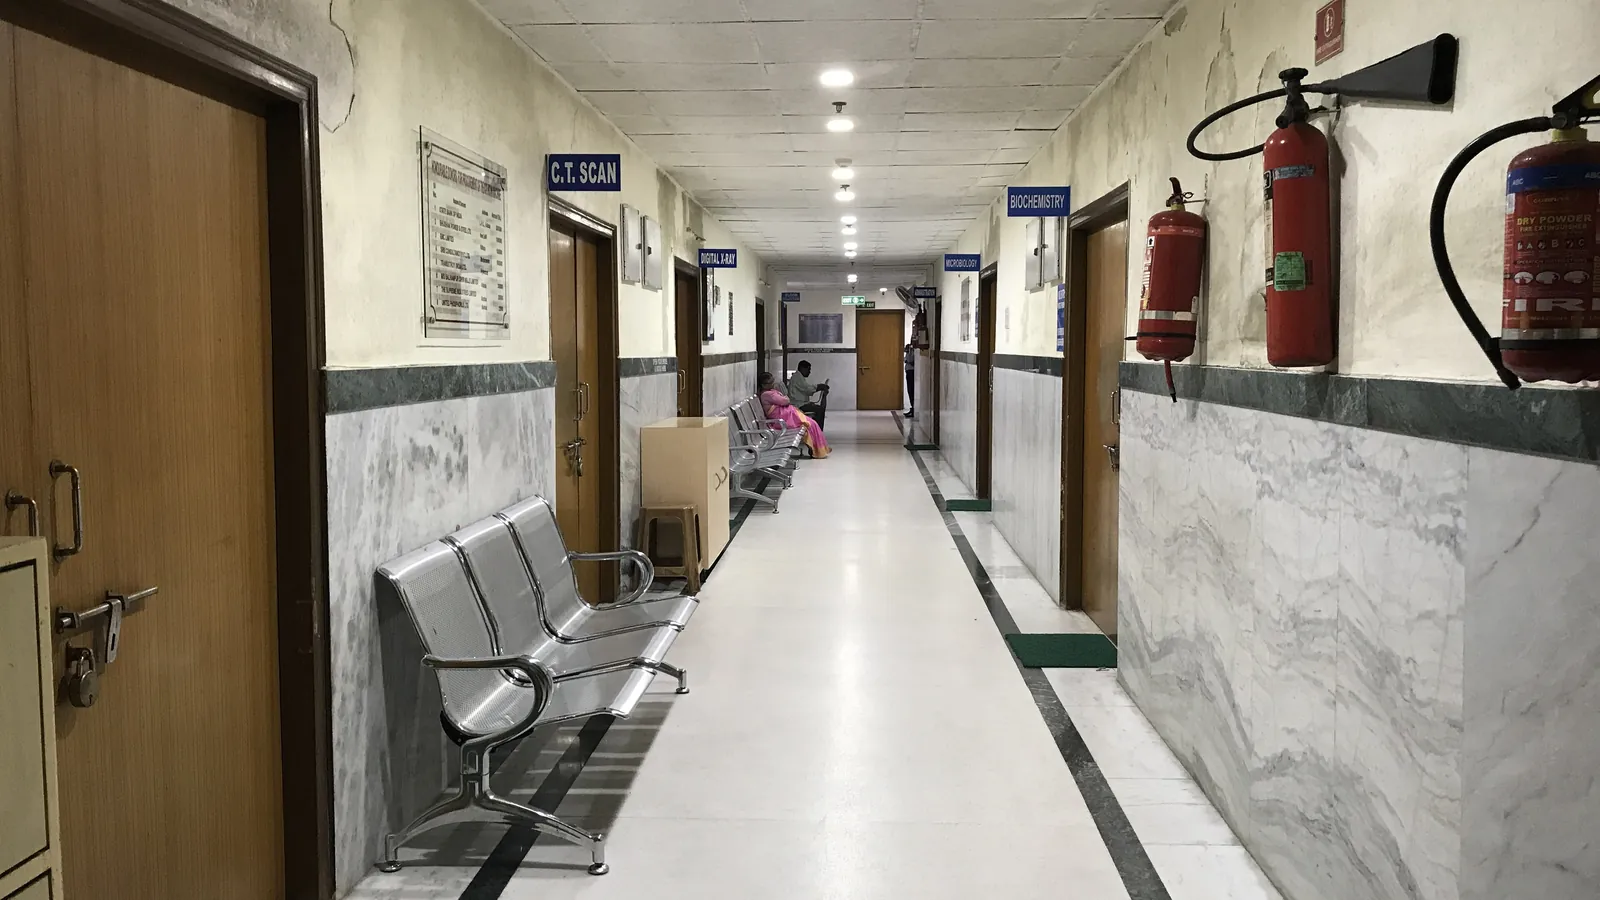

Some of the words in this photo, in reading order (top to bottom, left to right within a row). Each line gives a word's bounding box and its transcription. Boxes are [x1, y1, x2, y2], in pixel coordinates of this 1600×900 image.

[551, 161, 576, 184] C.T.
[579, 161, 617, 184] SCAN
[1512, 177, 1524, 186] ABC
[1010, 194, 1065, 209] BIOCHEMISTRY
[1517, 217, 1536, 226] DRY
[1539, 214, 1593, 224] POWDER
[1534, 223, 1588, 232] EXTINGUISHER
[1551, 239, 1559, 248] B
[700, 252, 720, 265] DIGITAL
[720, 252, 736, 265] X-RAY
[945, 258, 977, 268] MICROBIOLOGY
